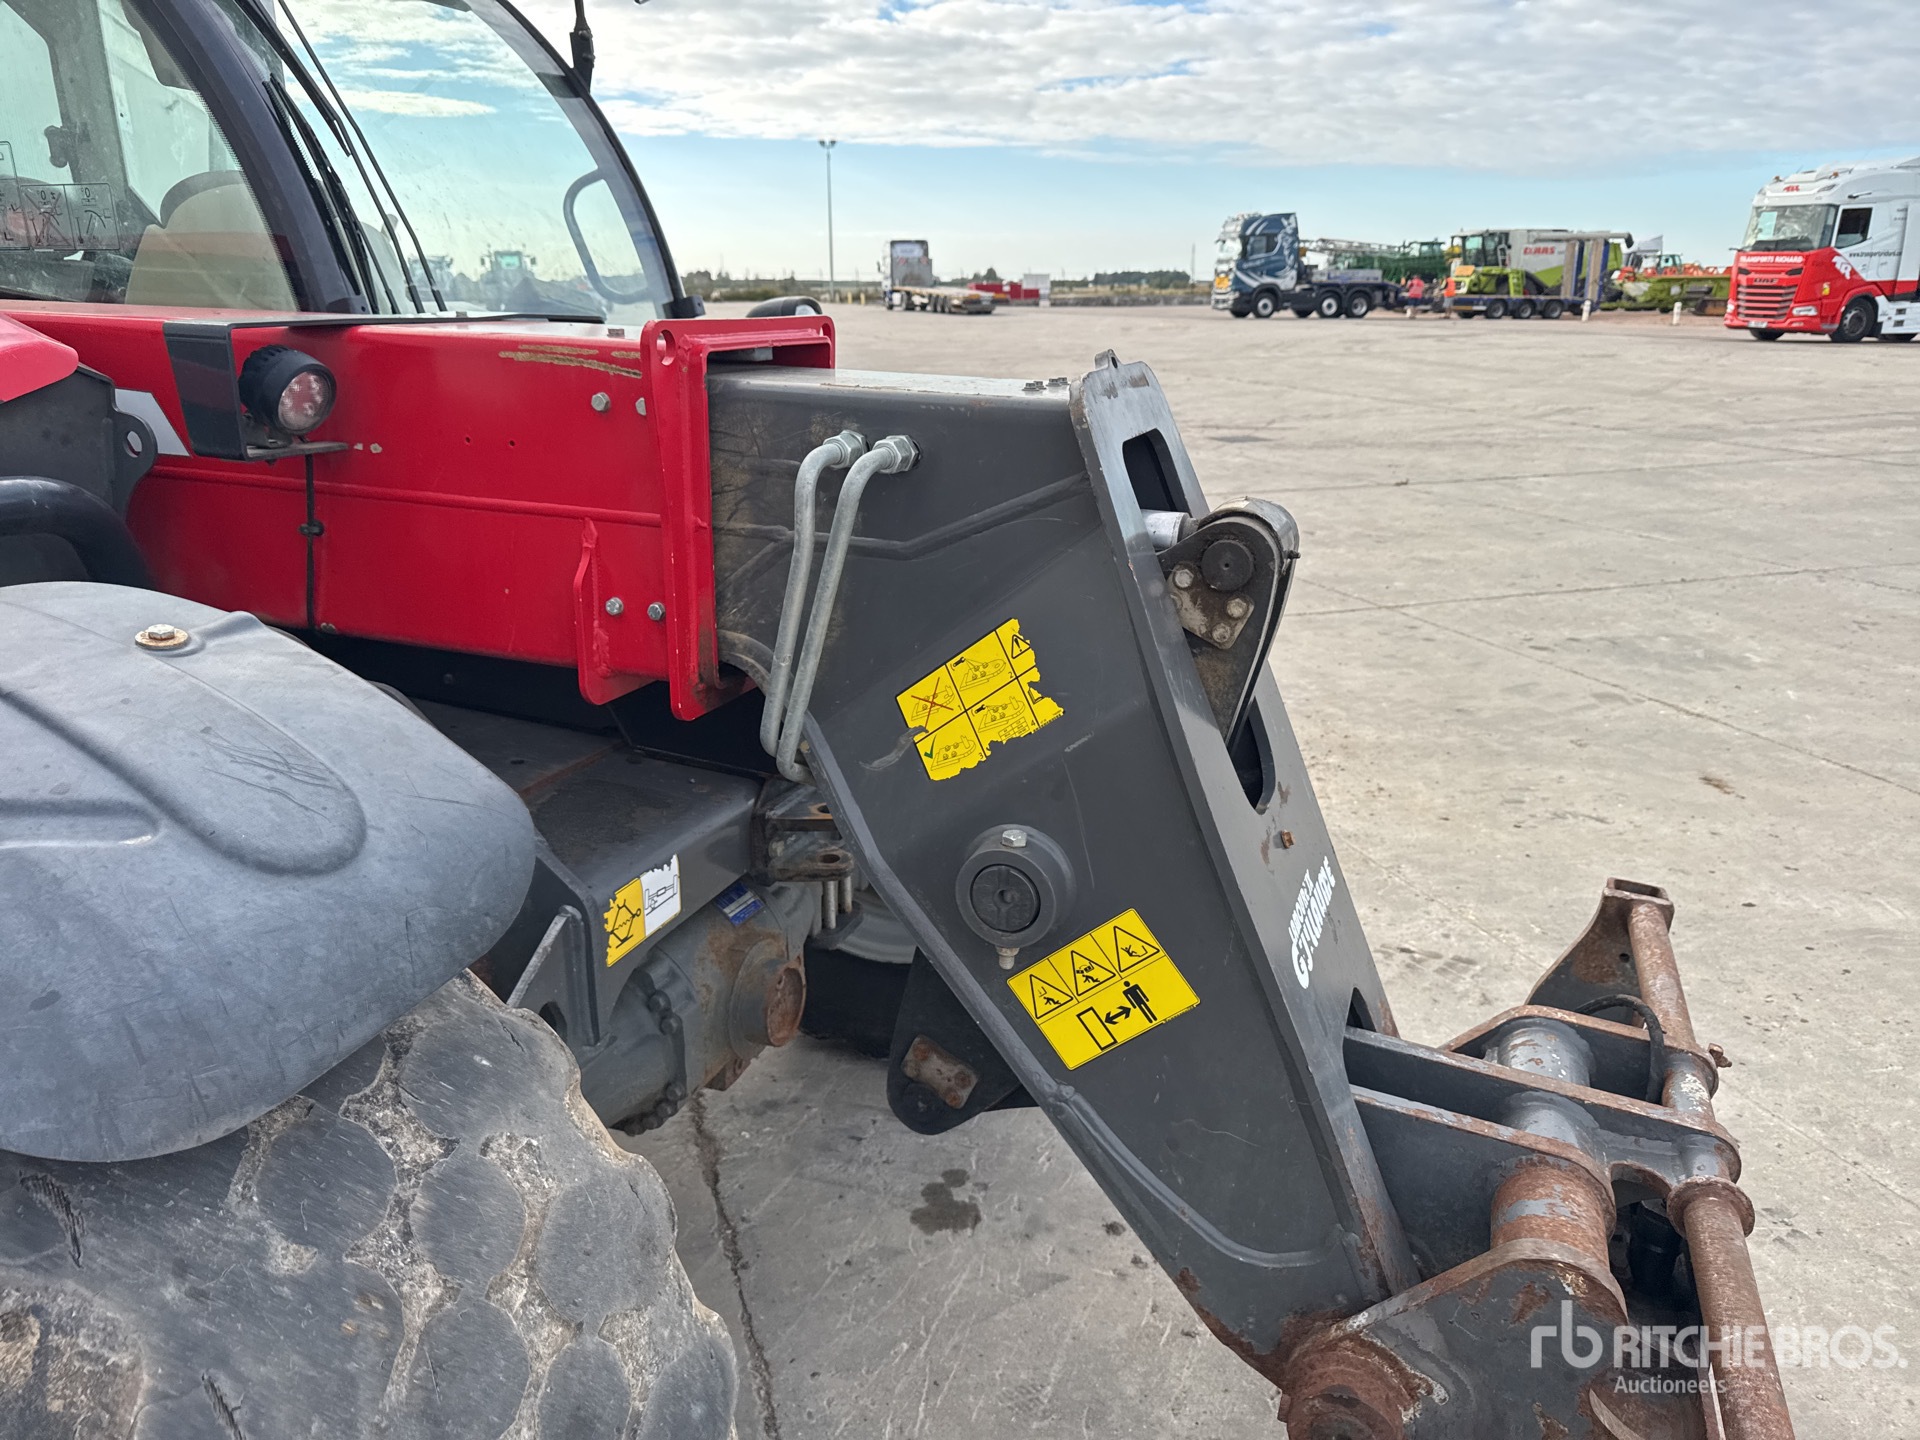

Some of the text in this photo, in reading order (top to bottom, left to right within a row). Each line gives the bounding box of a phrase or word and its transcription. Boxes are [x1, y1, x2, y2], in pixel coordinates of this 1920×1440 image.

[1524, 246, 1555, 254] CLAAS
[1740, 255, 1804, 263] TRANSPORTS RICHARD
